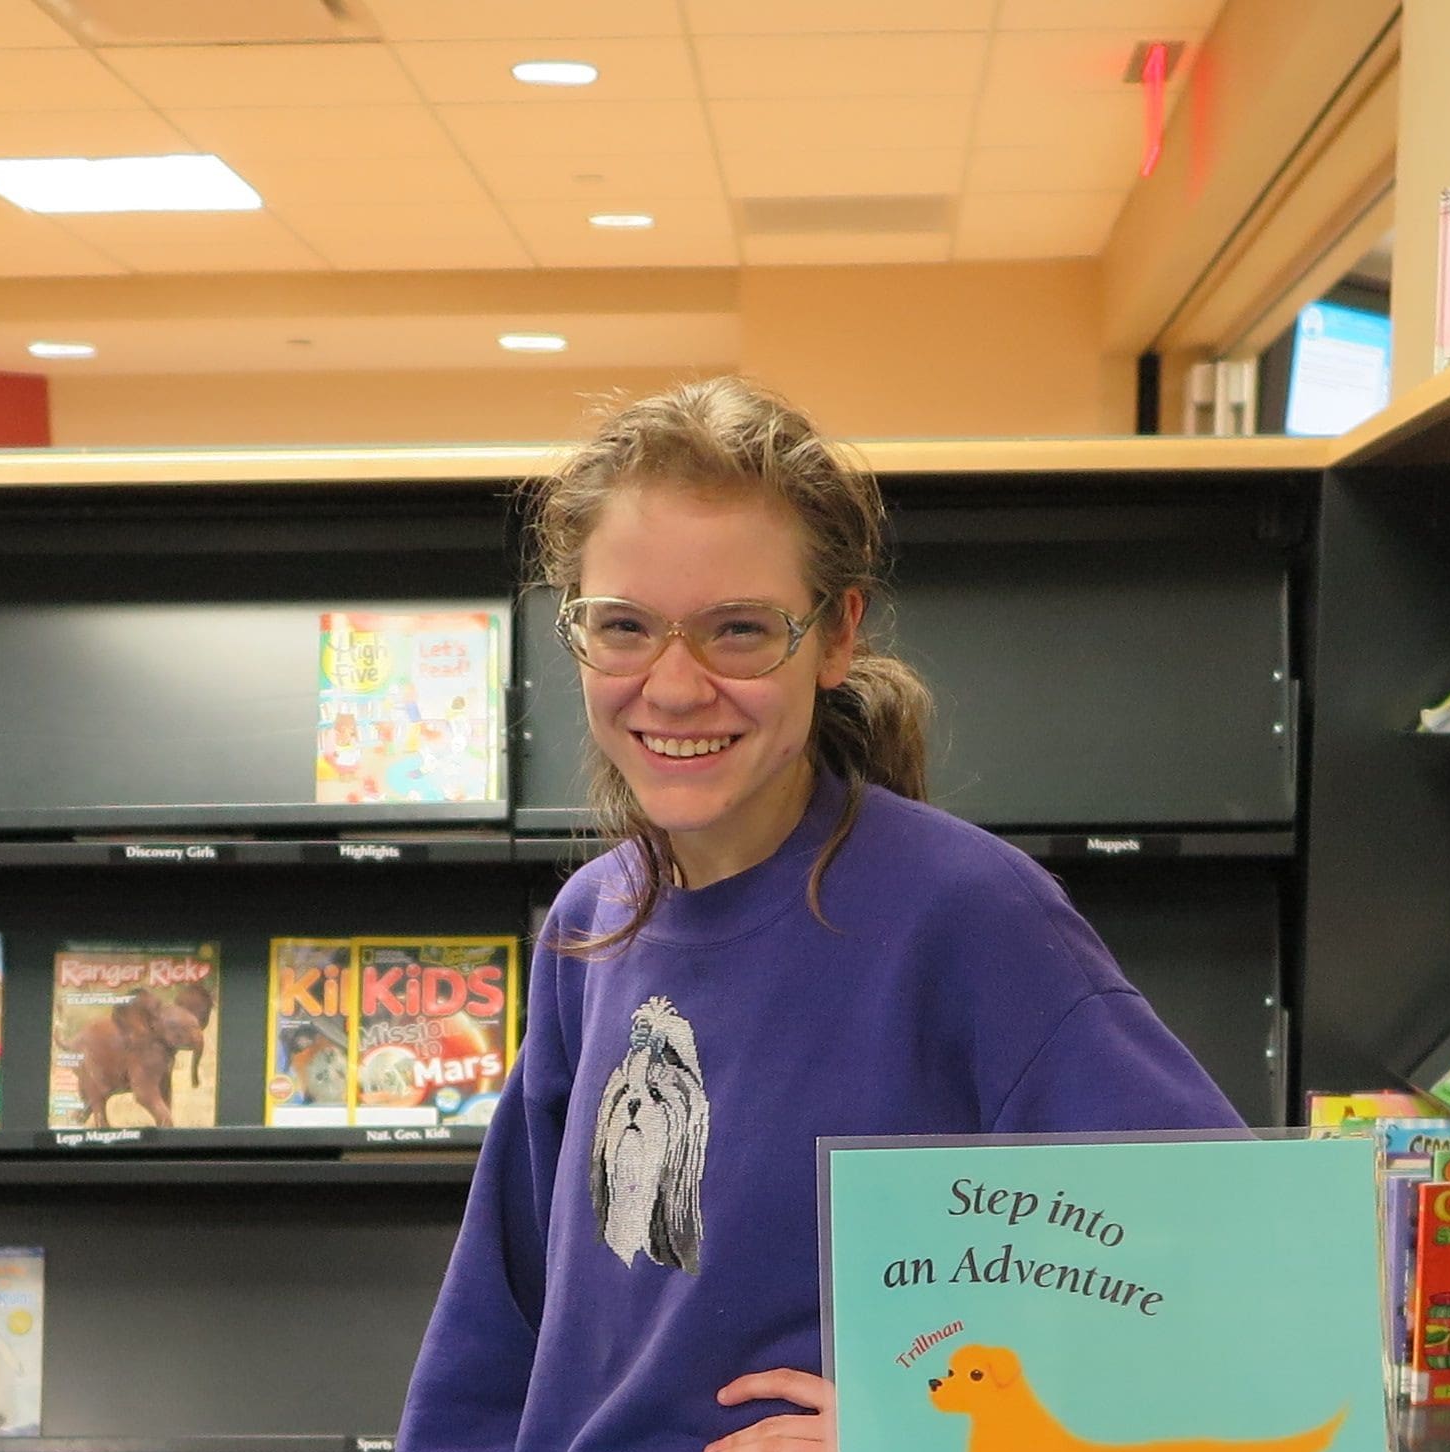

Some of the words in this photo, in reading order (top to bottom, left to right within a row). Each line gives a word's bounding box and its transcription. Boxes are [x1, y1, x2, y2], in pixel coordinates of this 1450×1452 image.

[125, 846, 183, 860] Discovery
[186, 846, 216, 858] Girls
[339, 844, 399, 860] Highlights
[1086, 837, 1140, 856] Muppets
[61, 959, 145, 988] Ranger
[358, 1017, 449, 1050] Missio
[413, 1053, 502, 1088] Mars
[56, 1132, 83, 1145] Lego
[85, 1130, 141, 1144] Magazine
[366, 1129, 391, 1141] Nat.
[394, 1128, 422, 1141] Geo.
[425, 1127, 450, 1139] Kids
[948, 1177, 1040, 1226] Step
[1047, 1188, 1126, 1249] into
[883, 1253, 935, 1289] an
[948, 1244, 1164, 1318] Adventure
[895, 1317, 966, 1371] Trillman
[356, 1438, 393, 1452] Sports
